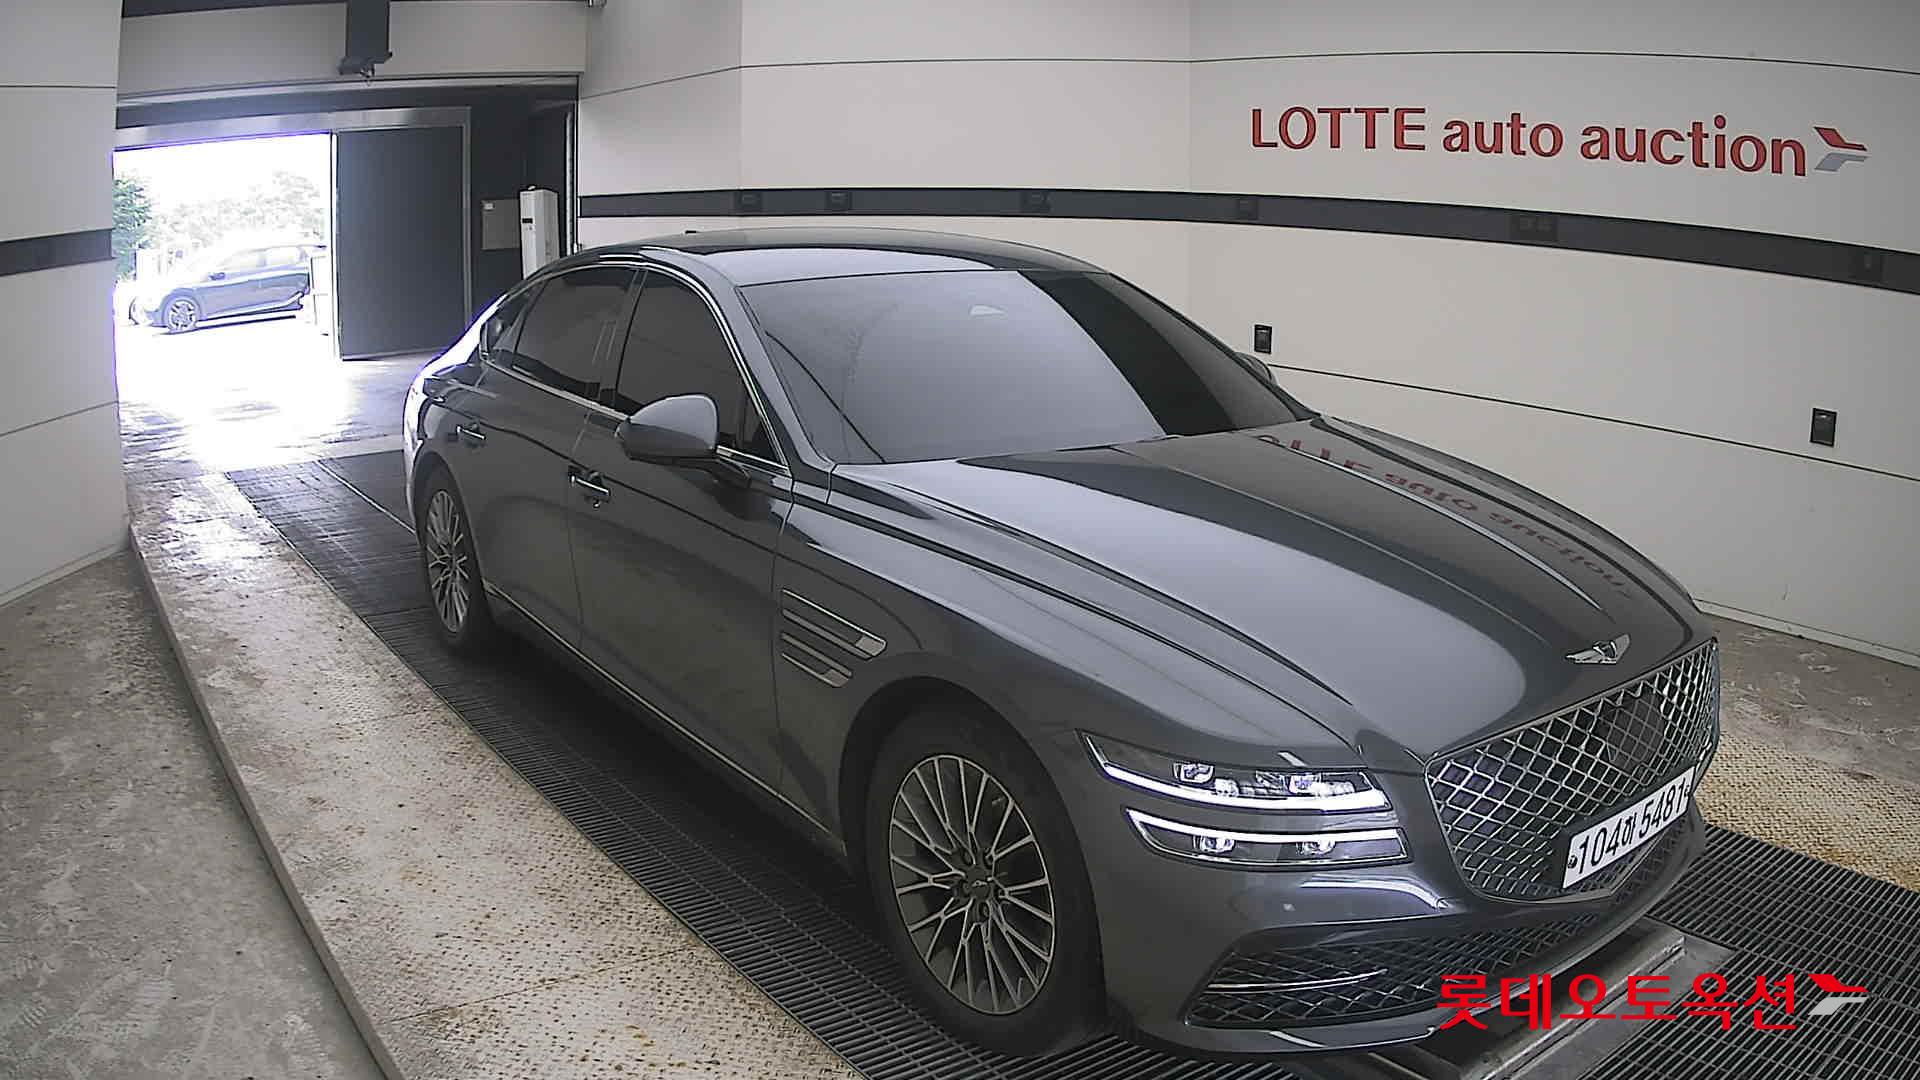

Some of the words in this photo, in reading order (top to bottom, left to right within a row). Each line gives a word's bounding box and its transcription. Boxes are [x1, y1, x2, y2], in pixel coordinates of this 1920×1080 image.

[1252, 106, 1426, 151] LOTTE
[1442, 112, 1565, 158] auto
[1580, 115, 1807, 178] auction
[1578, 812, 1638, 875] 104하
[1638, 777, 1687, 839] 5481
